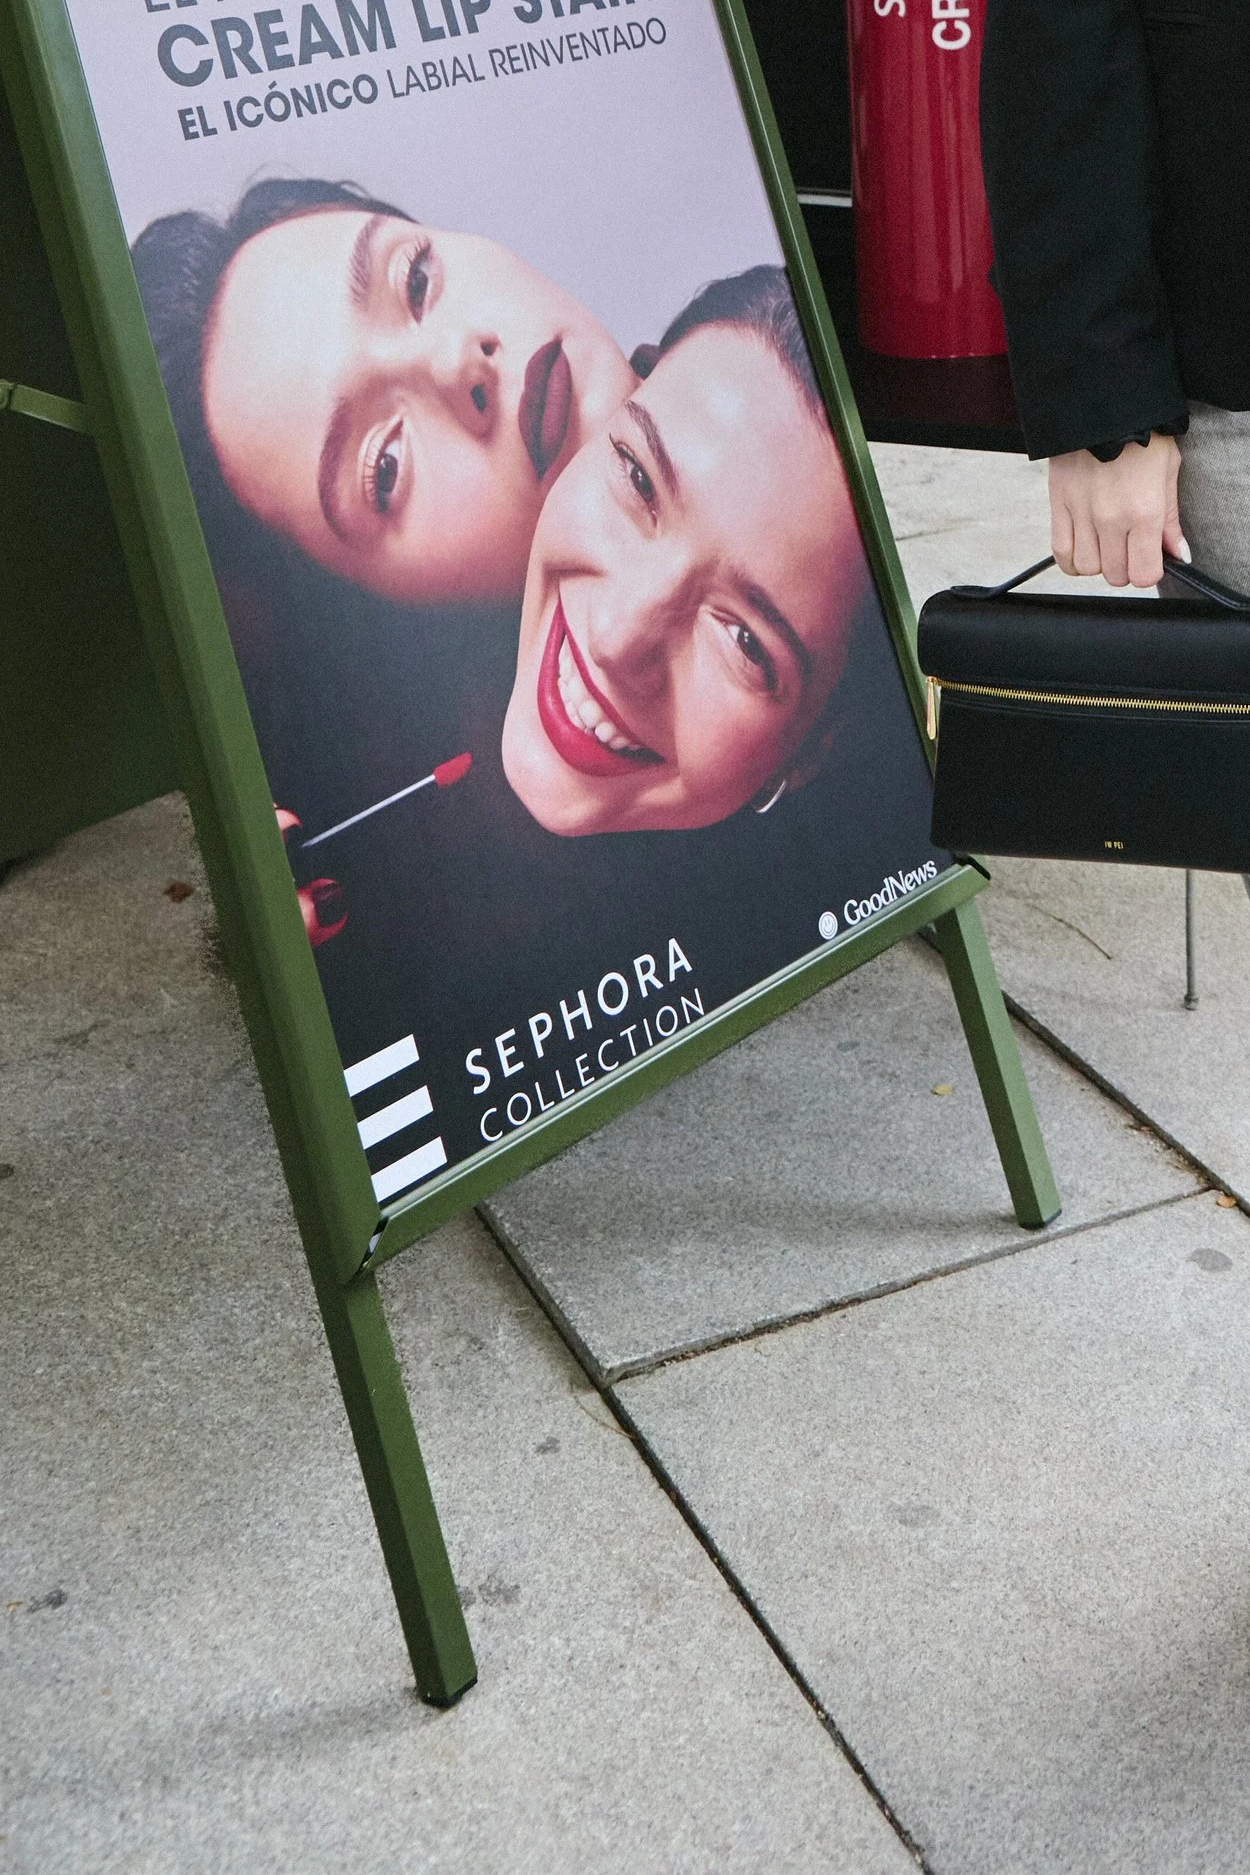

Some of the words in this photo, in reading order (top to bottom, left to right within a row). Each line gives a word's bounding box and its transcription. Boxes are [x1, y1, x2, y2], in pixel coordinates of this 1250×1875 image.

[178, 105, 218, 142] EL
[227, 73, 379, 132] ICÓNICO
[386, 53, 486, 99] LABIAL
[488, 17, 667, 79] REINVENTADO
[844, 859, 937, 926] GoodNews
[464, 937, 693, 1095] SEPHORA
[479, 987, 706, 1142] COLLECTION
